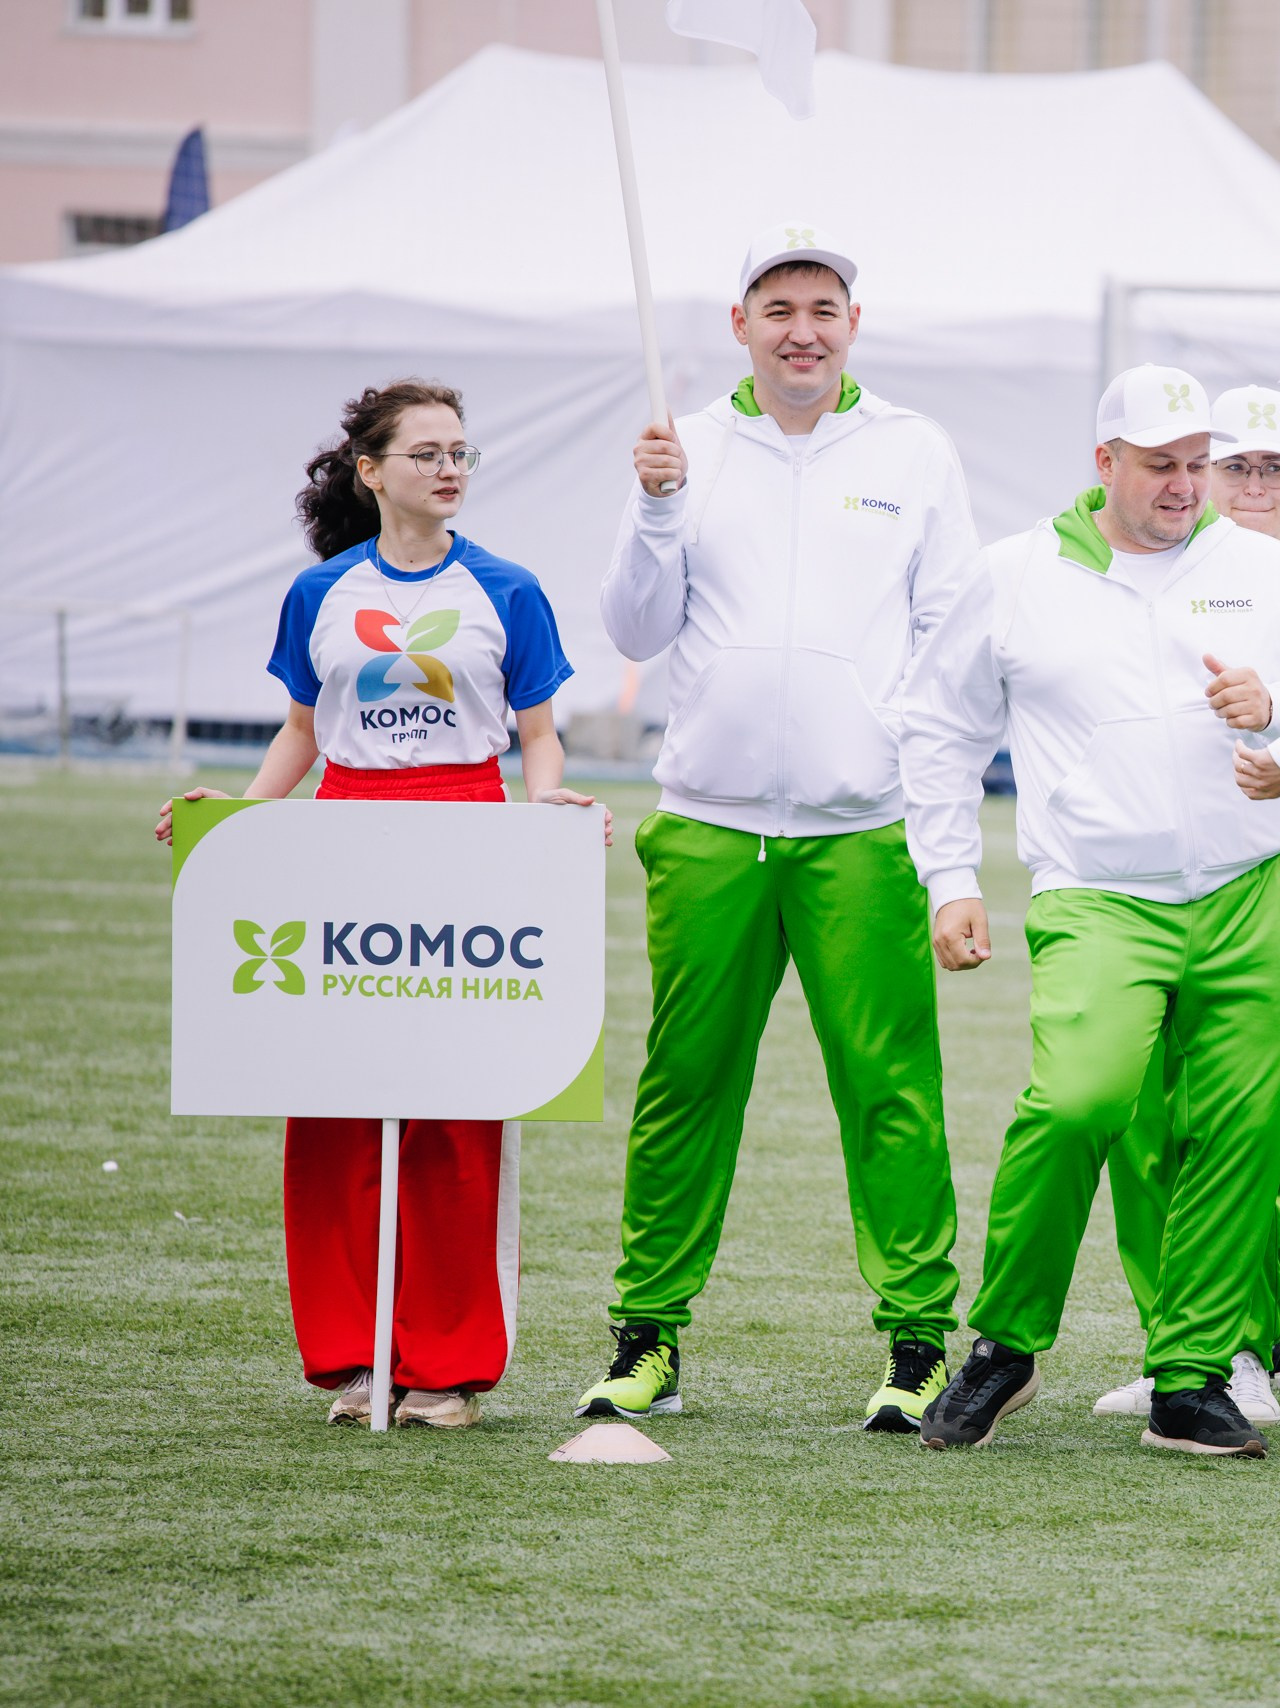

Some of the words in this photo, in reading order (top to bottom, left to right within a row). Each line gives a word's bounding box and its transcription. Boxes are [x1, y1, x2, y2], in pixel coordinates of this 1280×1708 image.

[862, 498, 901, 515] КОМОС
[1209, 599, 1253, 608] КОМОС
[360, 705, 456, 730] КОМОС
[323, 921, 544, 969] КОМОС
[322, 974, 452, 999] РУССКАЯ
[462, 977, 544, 1001] НИВА
